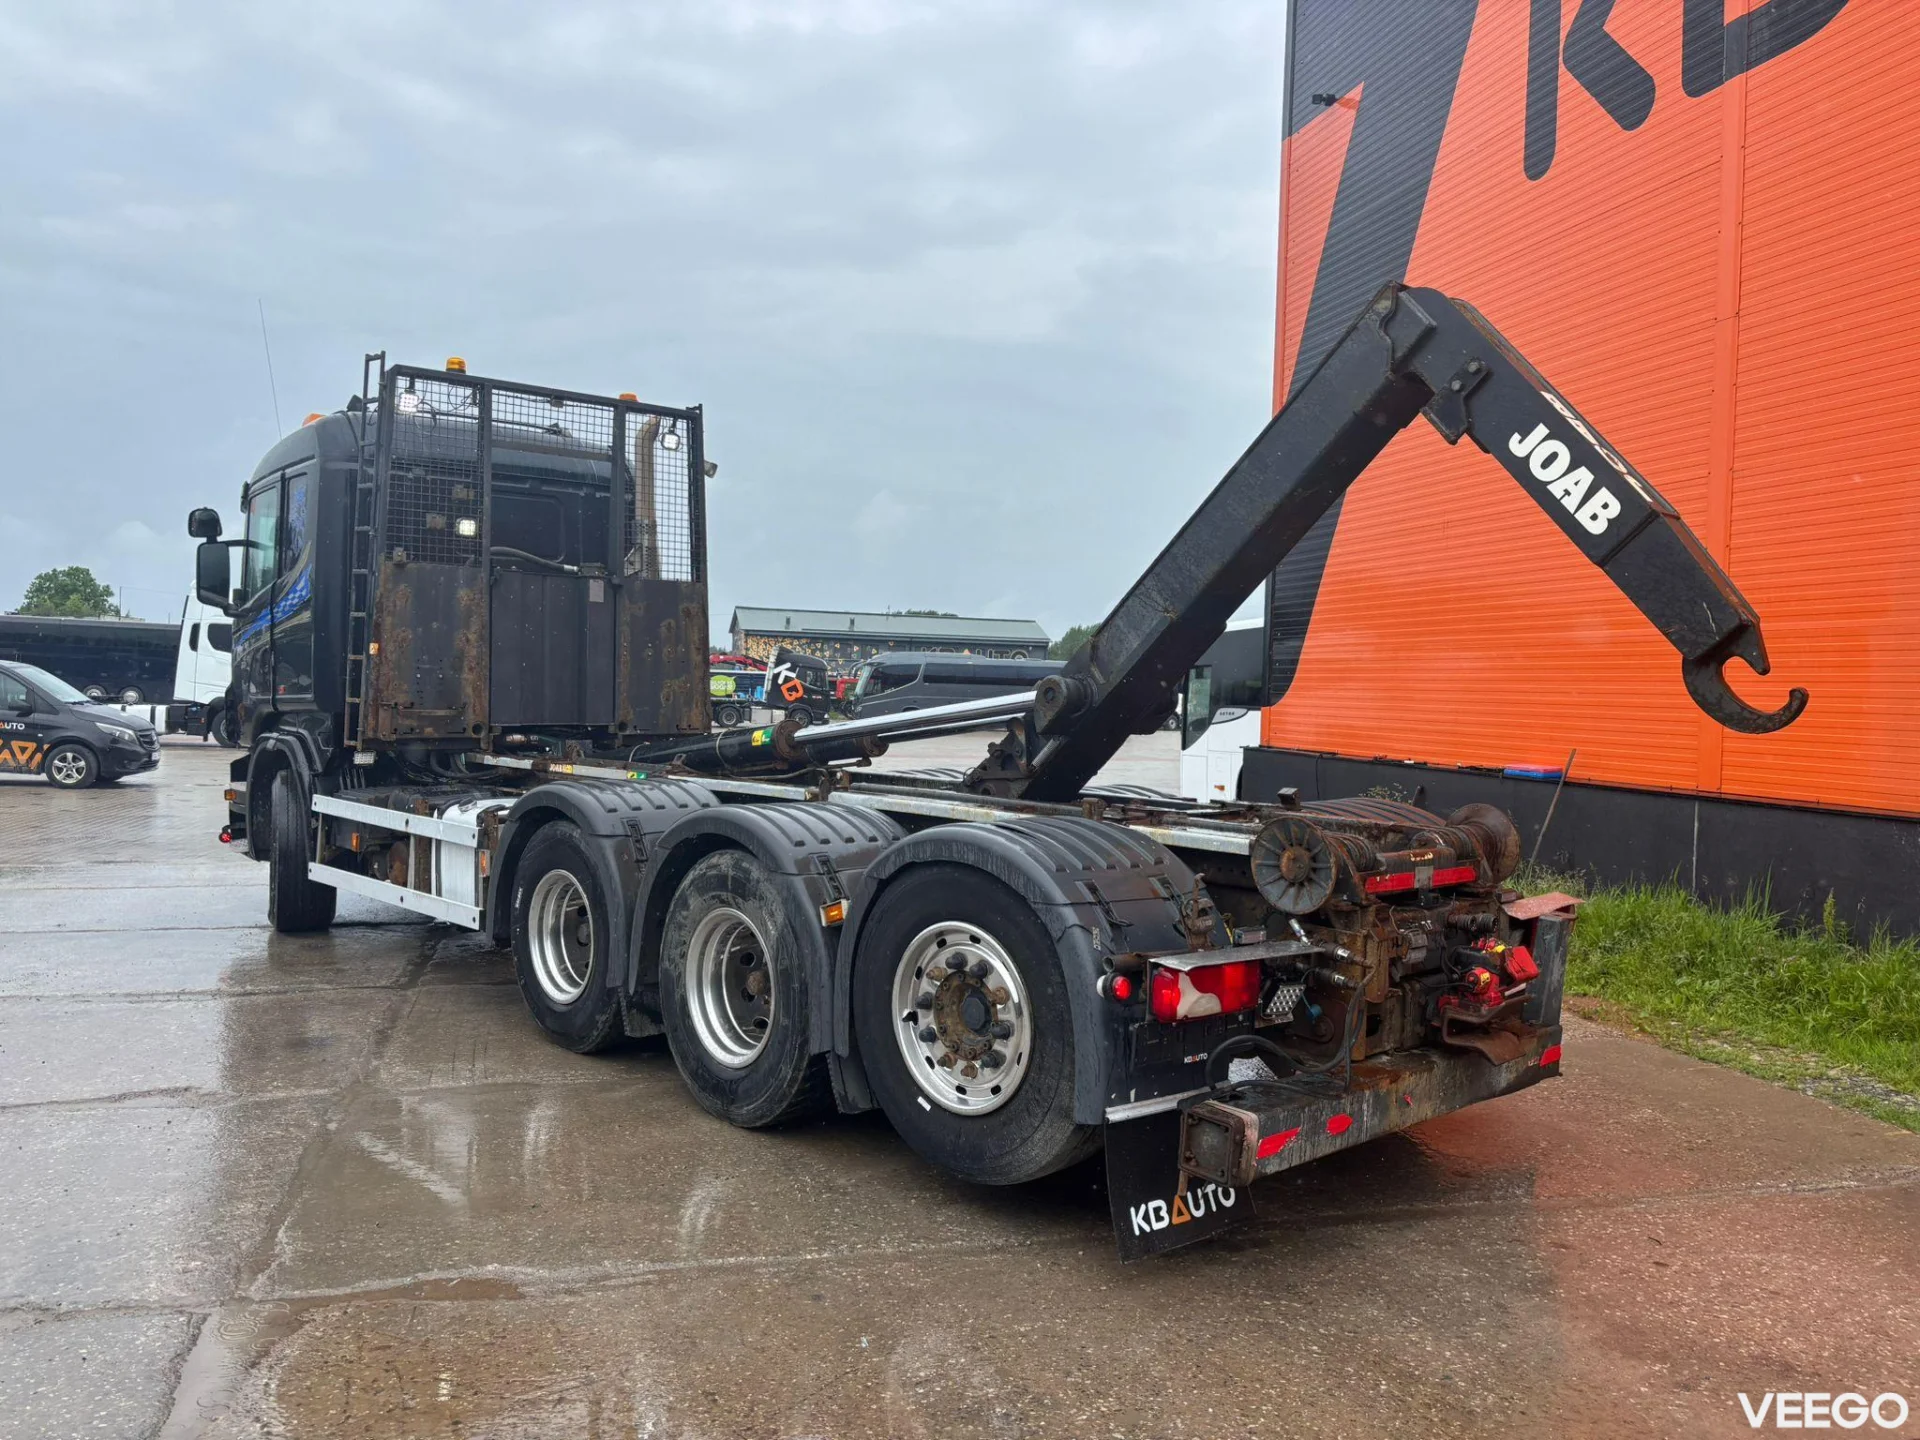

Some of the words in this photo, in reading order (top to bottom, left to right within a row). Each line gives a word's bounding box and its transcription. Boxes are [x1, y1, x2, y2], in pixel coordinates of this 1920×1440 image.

[1508, 422, 1622, 535] JOAB
[773, 662, 804, 702] KB
[1183, 1053, 1209, 1064] KBAUTO
[1129, 1182, 1236, 1236] KBAUTO
